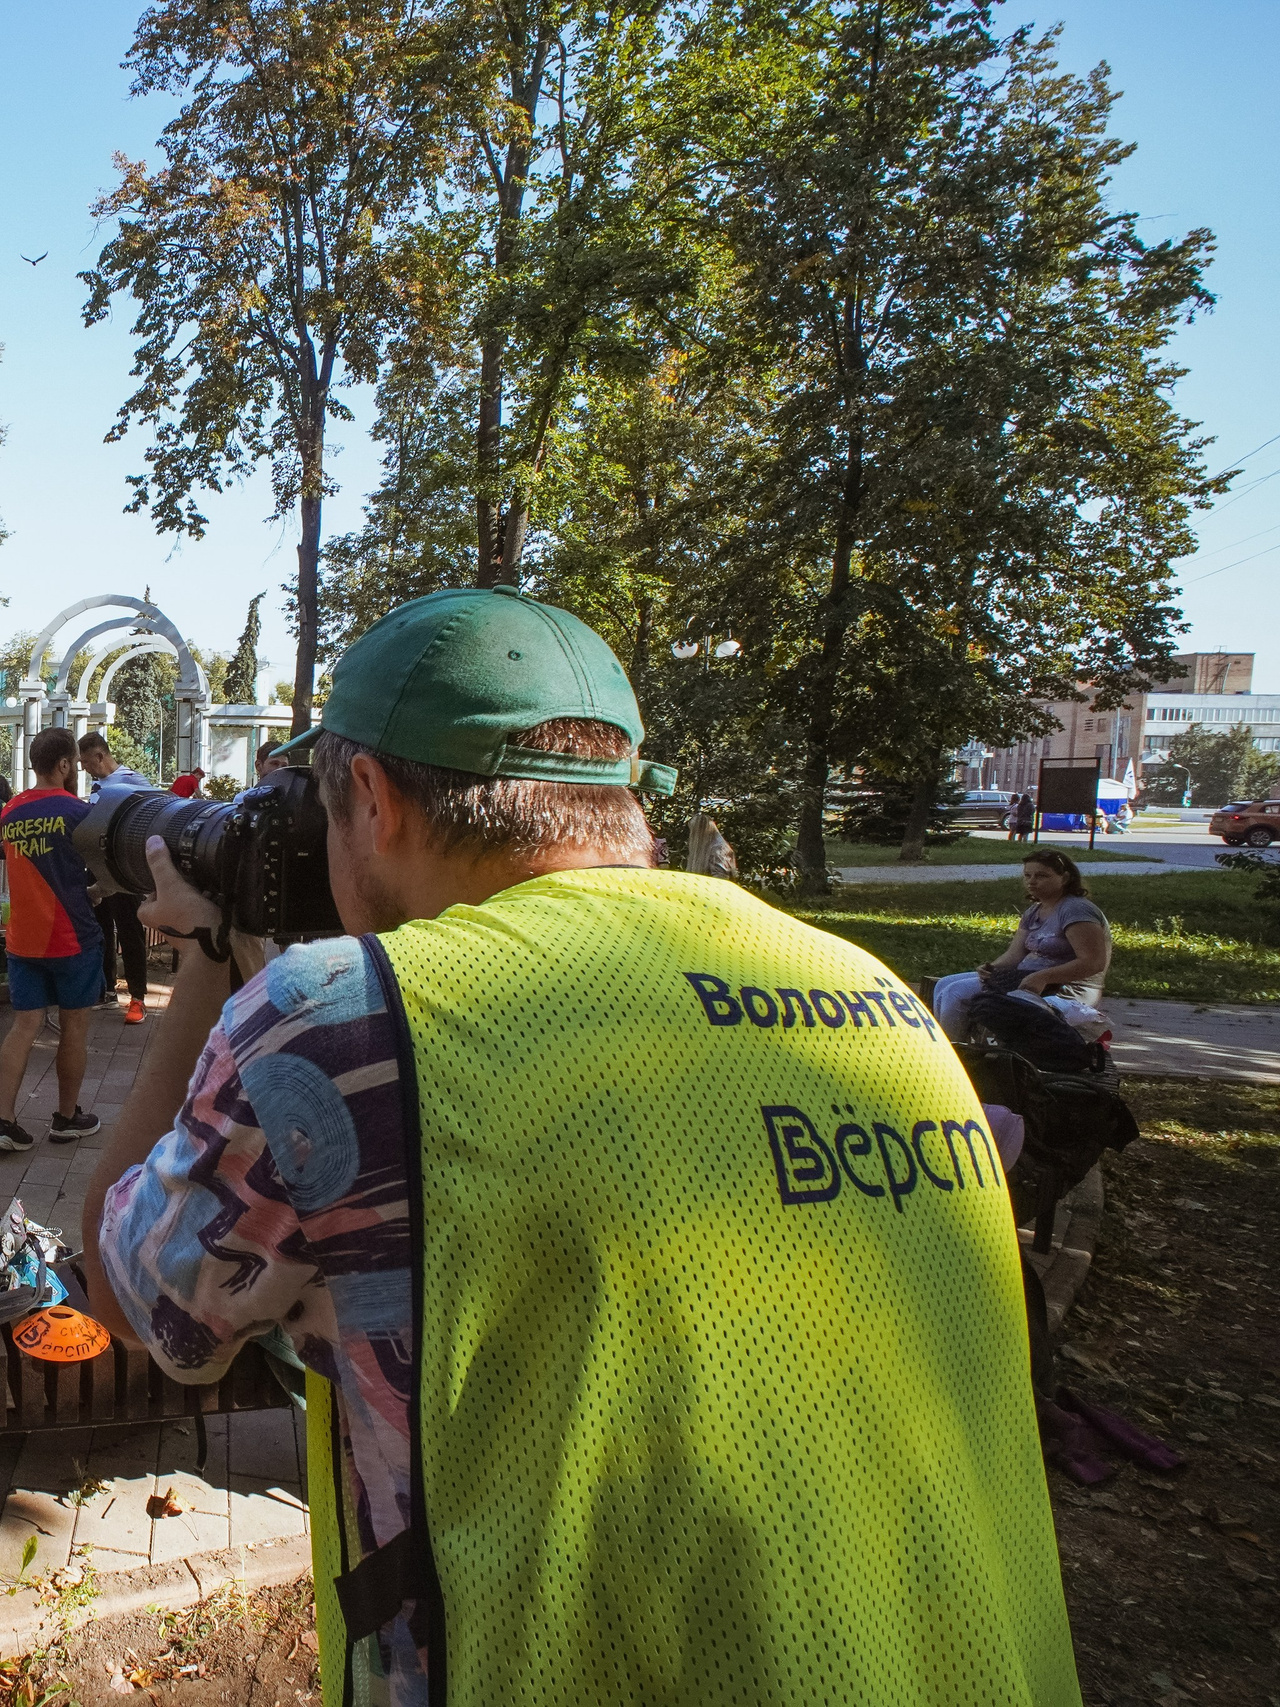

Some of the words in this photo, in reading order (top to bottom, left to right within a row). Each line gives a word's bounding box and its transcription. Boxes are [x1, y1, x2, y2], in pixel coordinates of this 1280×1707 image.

[1, 815, 66, 840] UGRESHA
[10, 837, 54, 859] TRAIL
[682, 971, 937, 1042] Волонтёр
